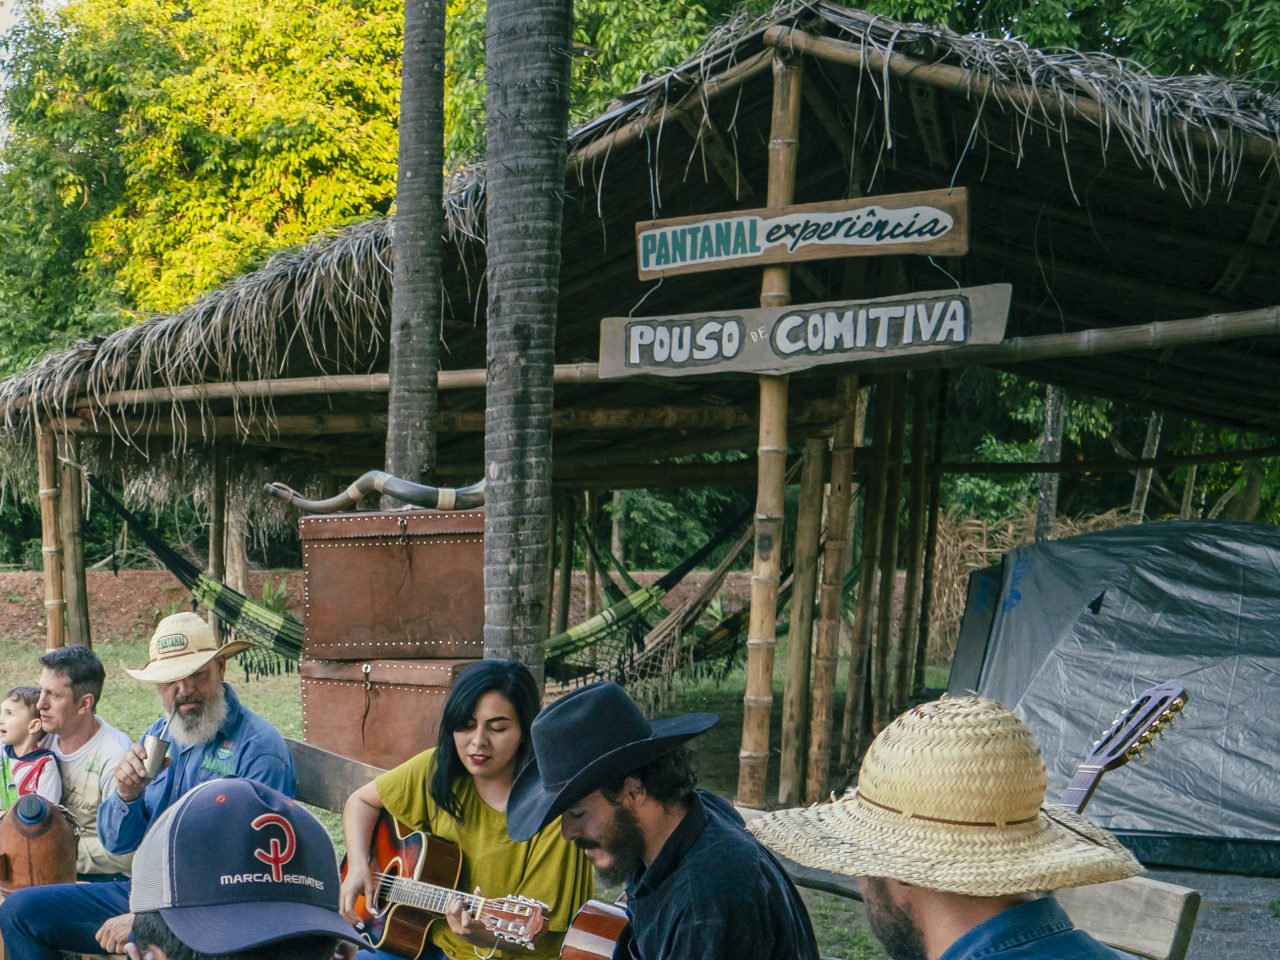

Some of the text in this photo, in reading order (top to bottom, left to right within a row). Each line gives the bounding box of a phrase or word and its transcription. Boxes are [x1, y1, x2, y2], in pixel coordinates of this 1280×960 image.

[642, 208, 949, 269] PANTANAL experiência
[629, 301, 966, 364] POUSO DE COMITIVA
[220, 873, 272, 886] MARCA
